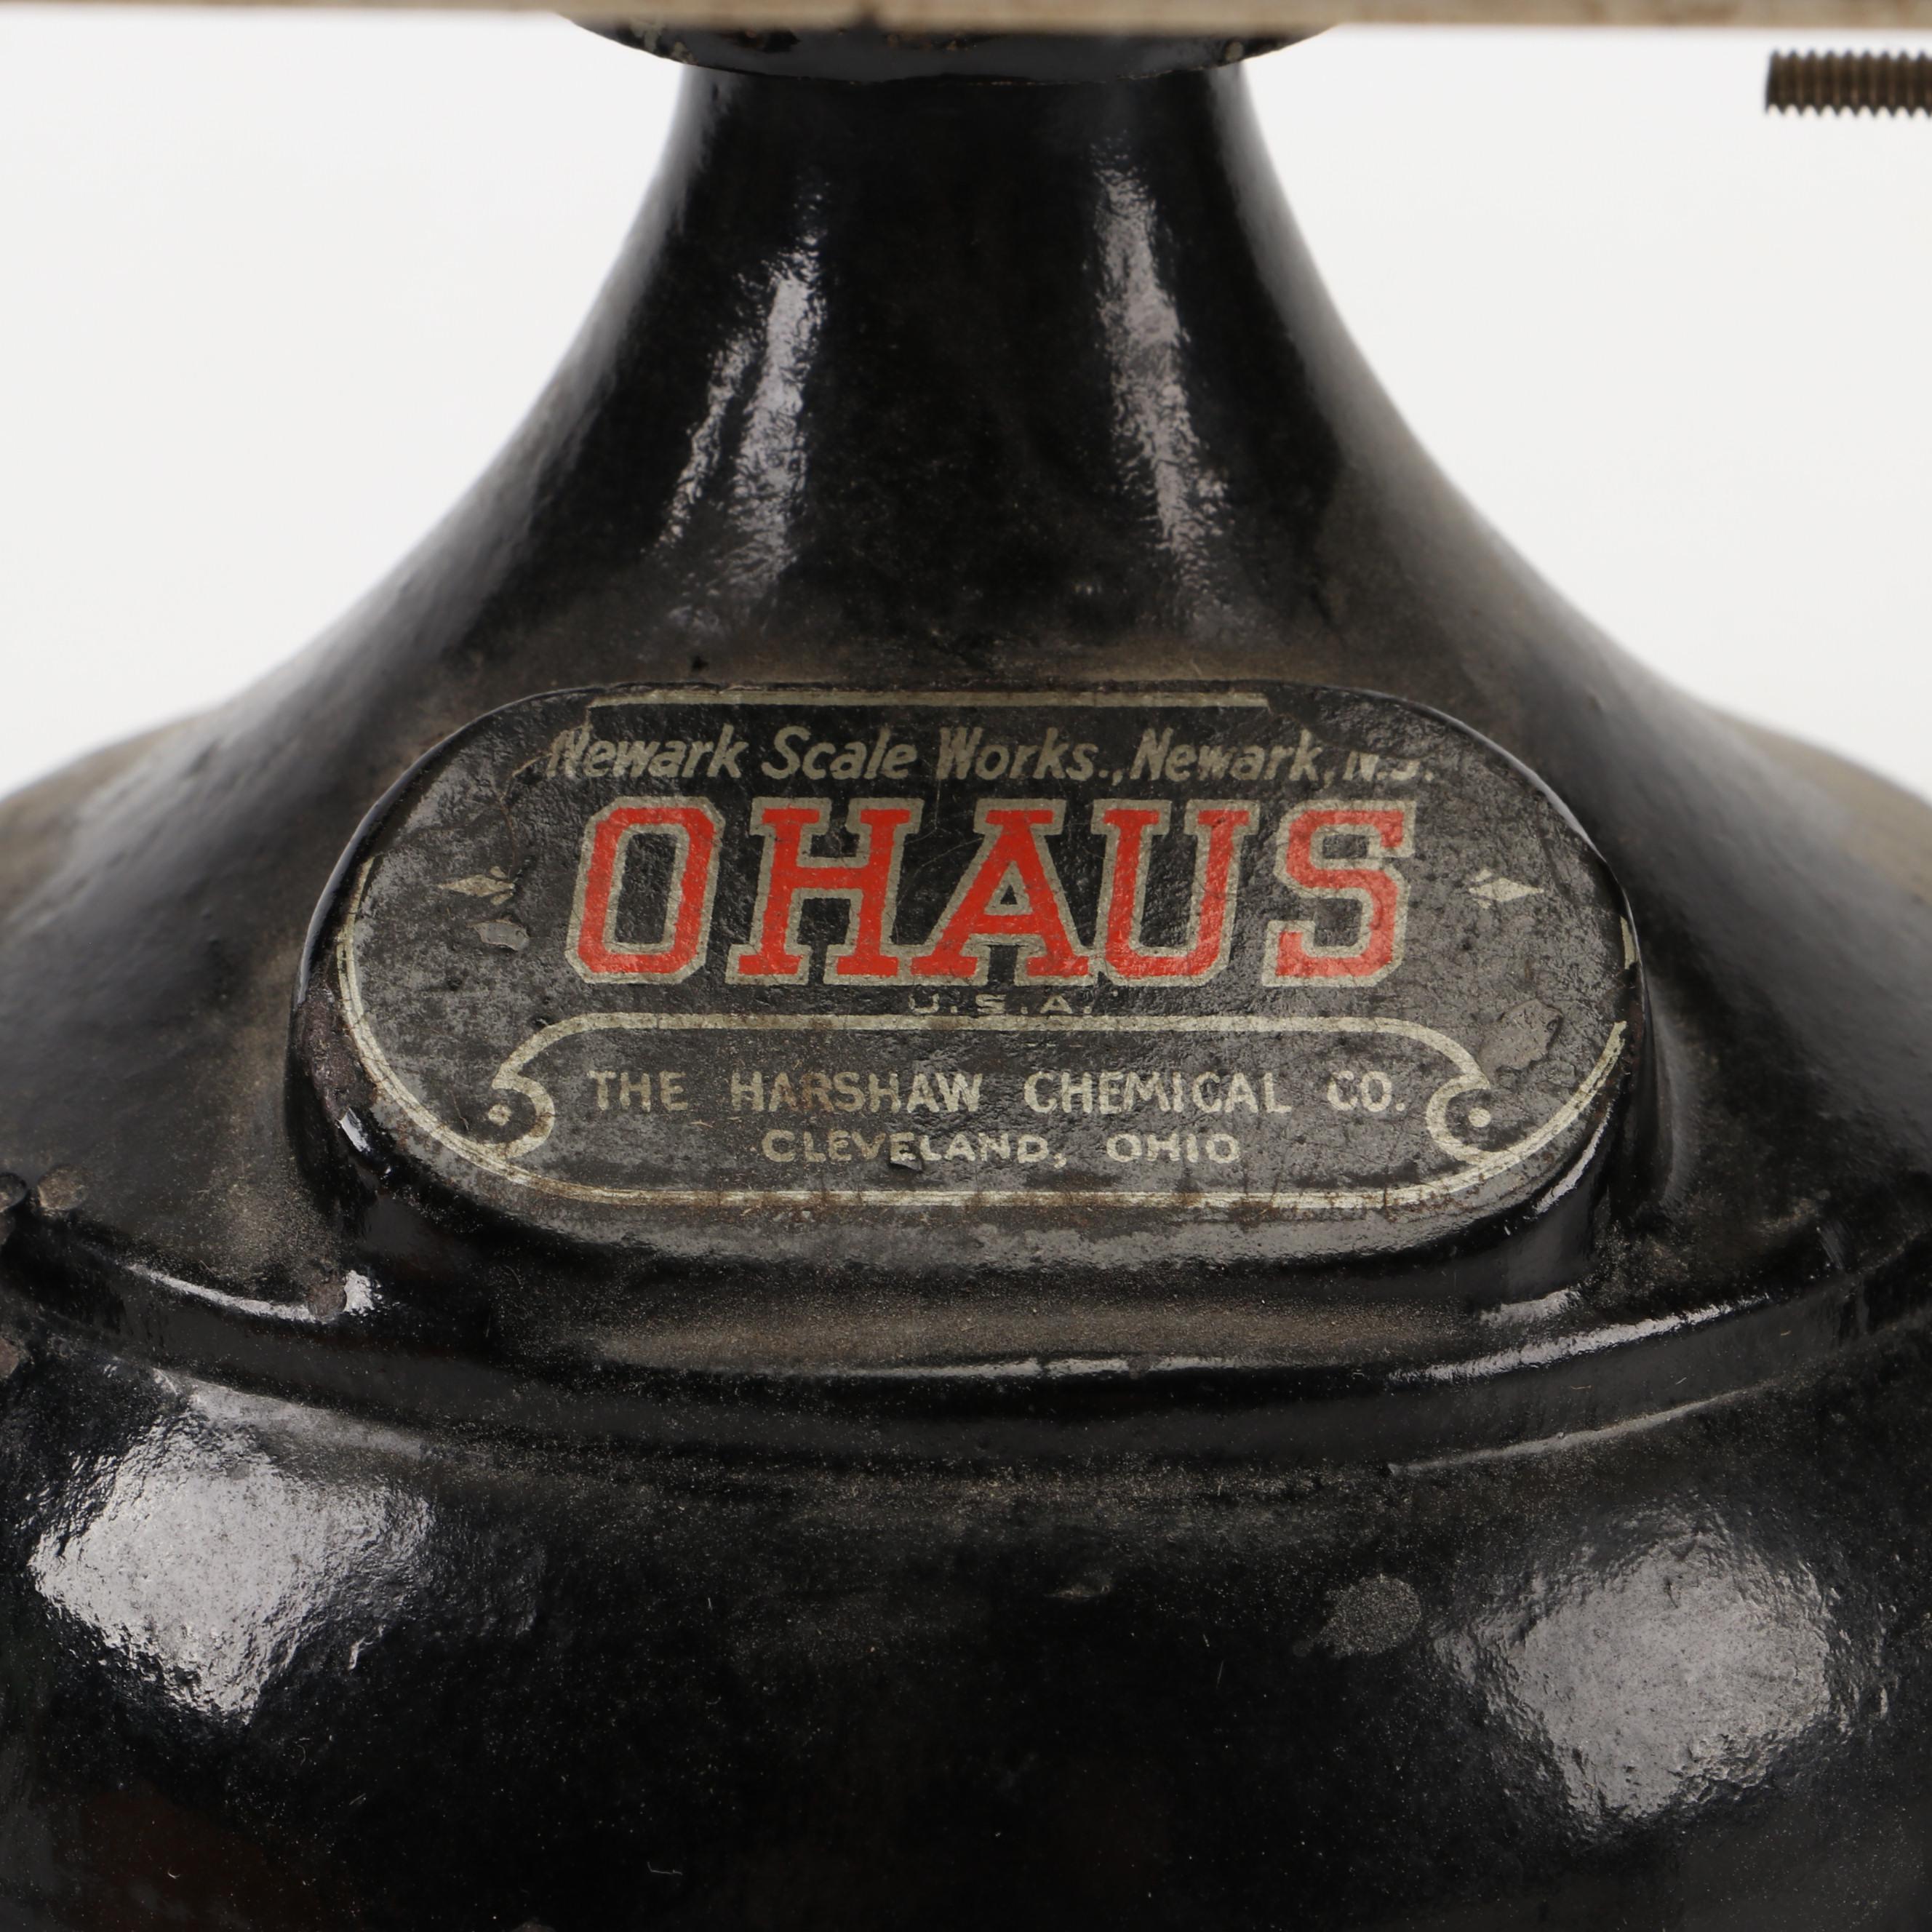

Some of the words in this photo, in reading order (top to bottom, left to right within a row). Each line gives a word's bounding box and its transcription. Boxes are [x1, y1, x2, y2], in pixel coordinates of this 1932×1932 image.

[546, 724, 749, 779] Newark
[760, 726, 917, 780] Scale
[1129, 727, 1335, 789] Newark,
[564, 796, 1416, 988] OHAUS
[909, 993, 1092, 1014] U.S.A.
[588, 1070, 688, 1112] THE
[730, 1070, 982, 1113] HARSHAW
[1023, 1070, 1292, 1114] CHEMICAL
[1326, 1070, 1405, 1113] CO.
[761, 1129, 1067, 1169] CLEVELAND,
[1106, 1132, 1241, 1165] OHIO
